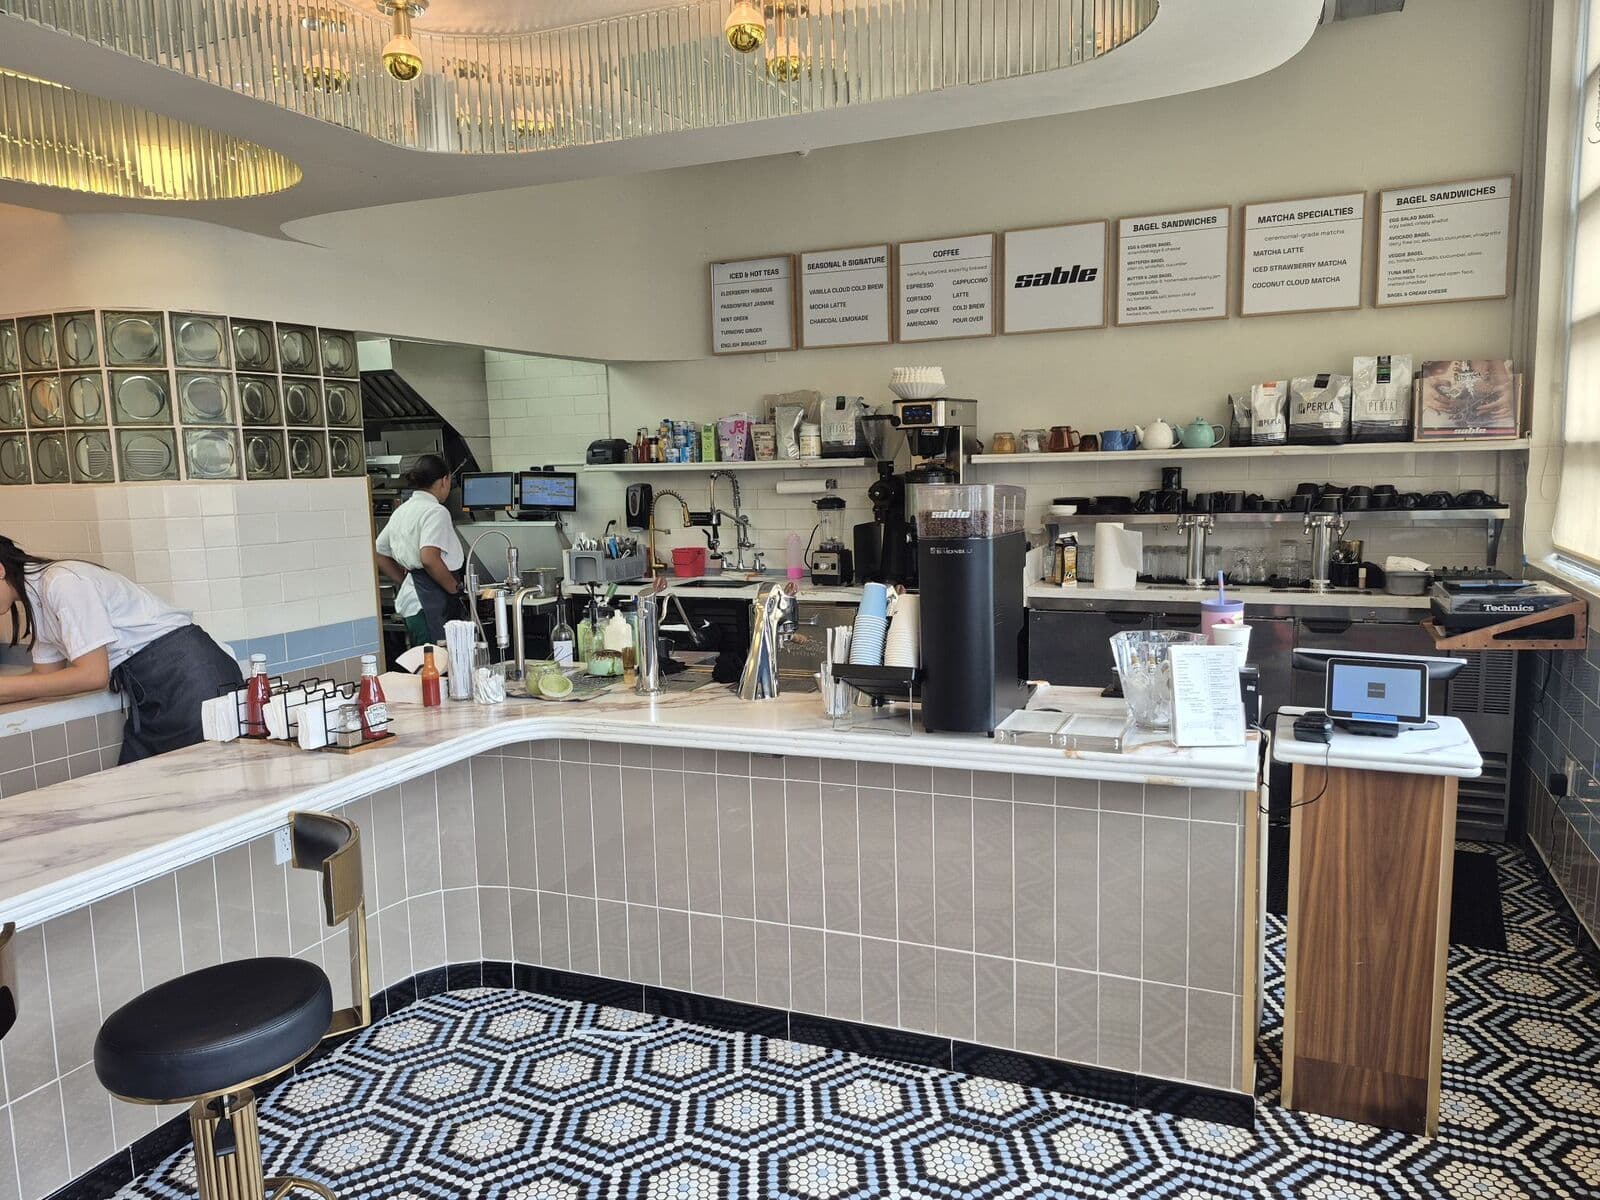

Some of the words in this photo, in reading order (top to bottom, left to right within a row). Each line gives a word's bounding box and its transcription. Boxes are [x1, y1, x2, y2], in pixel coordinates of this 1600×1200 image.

[1396, 195, 1427, 206] BAGEL
[1430, 186, 1496, 201] SANDWICHES
[1258, 214, 1295, 224] MATCHA
[1297, 207, 1353, 220] SPECIALTIES
[1133, 223, 1160, 232] BAGEL
[1161, 216, 1217, 228] SANDWICHES
[933, 249, 959, 257] COFFEE
[808, 261, 841, 270] SEASONAL
[848, 256, 885, 266] SIGNATURE
[1270, 262, 1315, 271] STRAWBERRY
[1318, 259, 1347, 267] MATCHA
[730, 272, 743, 280] ICED
[953, 277, 988, 285] CAPPUCCINO
[1015, 265, 1098, 288] sable
[1306, 402, 1334, 411] PER'LA
[932, 509, 971, 518] sable
[1483, 604, 1534, 612] Technics
